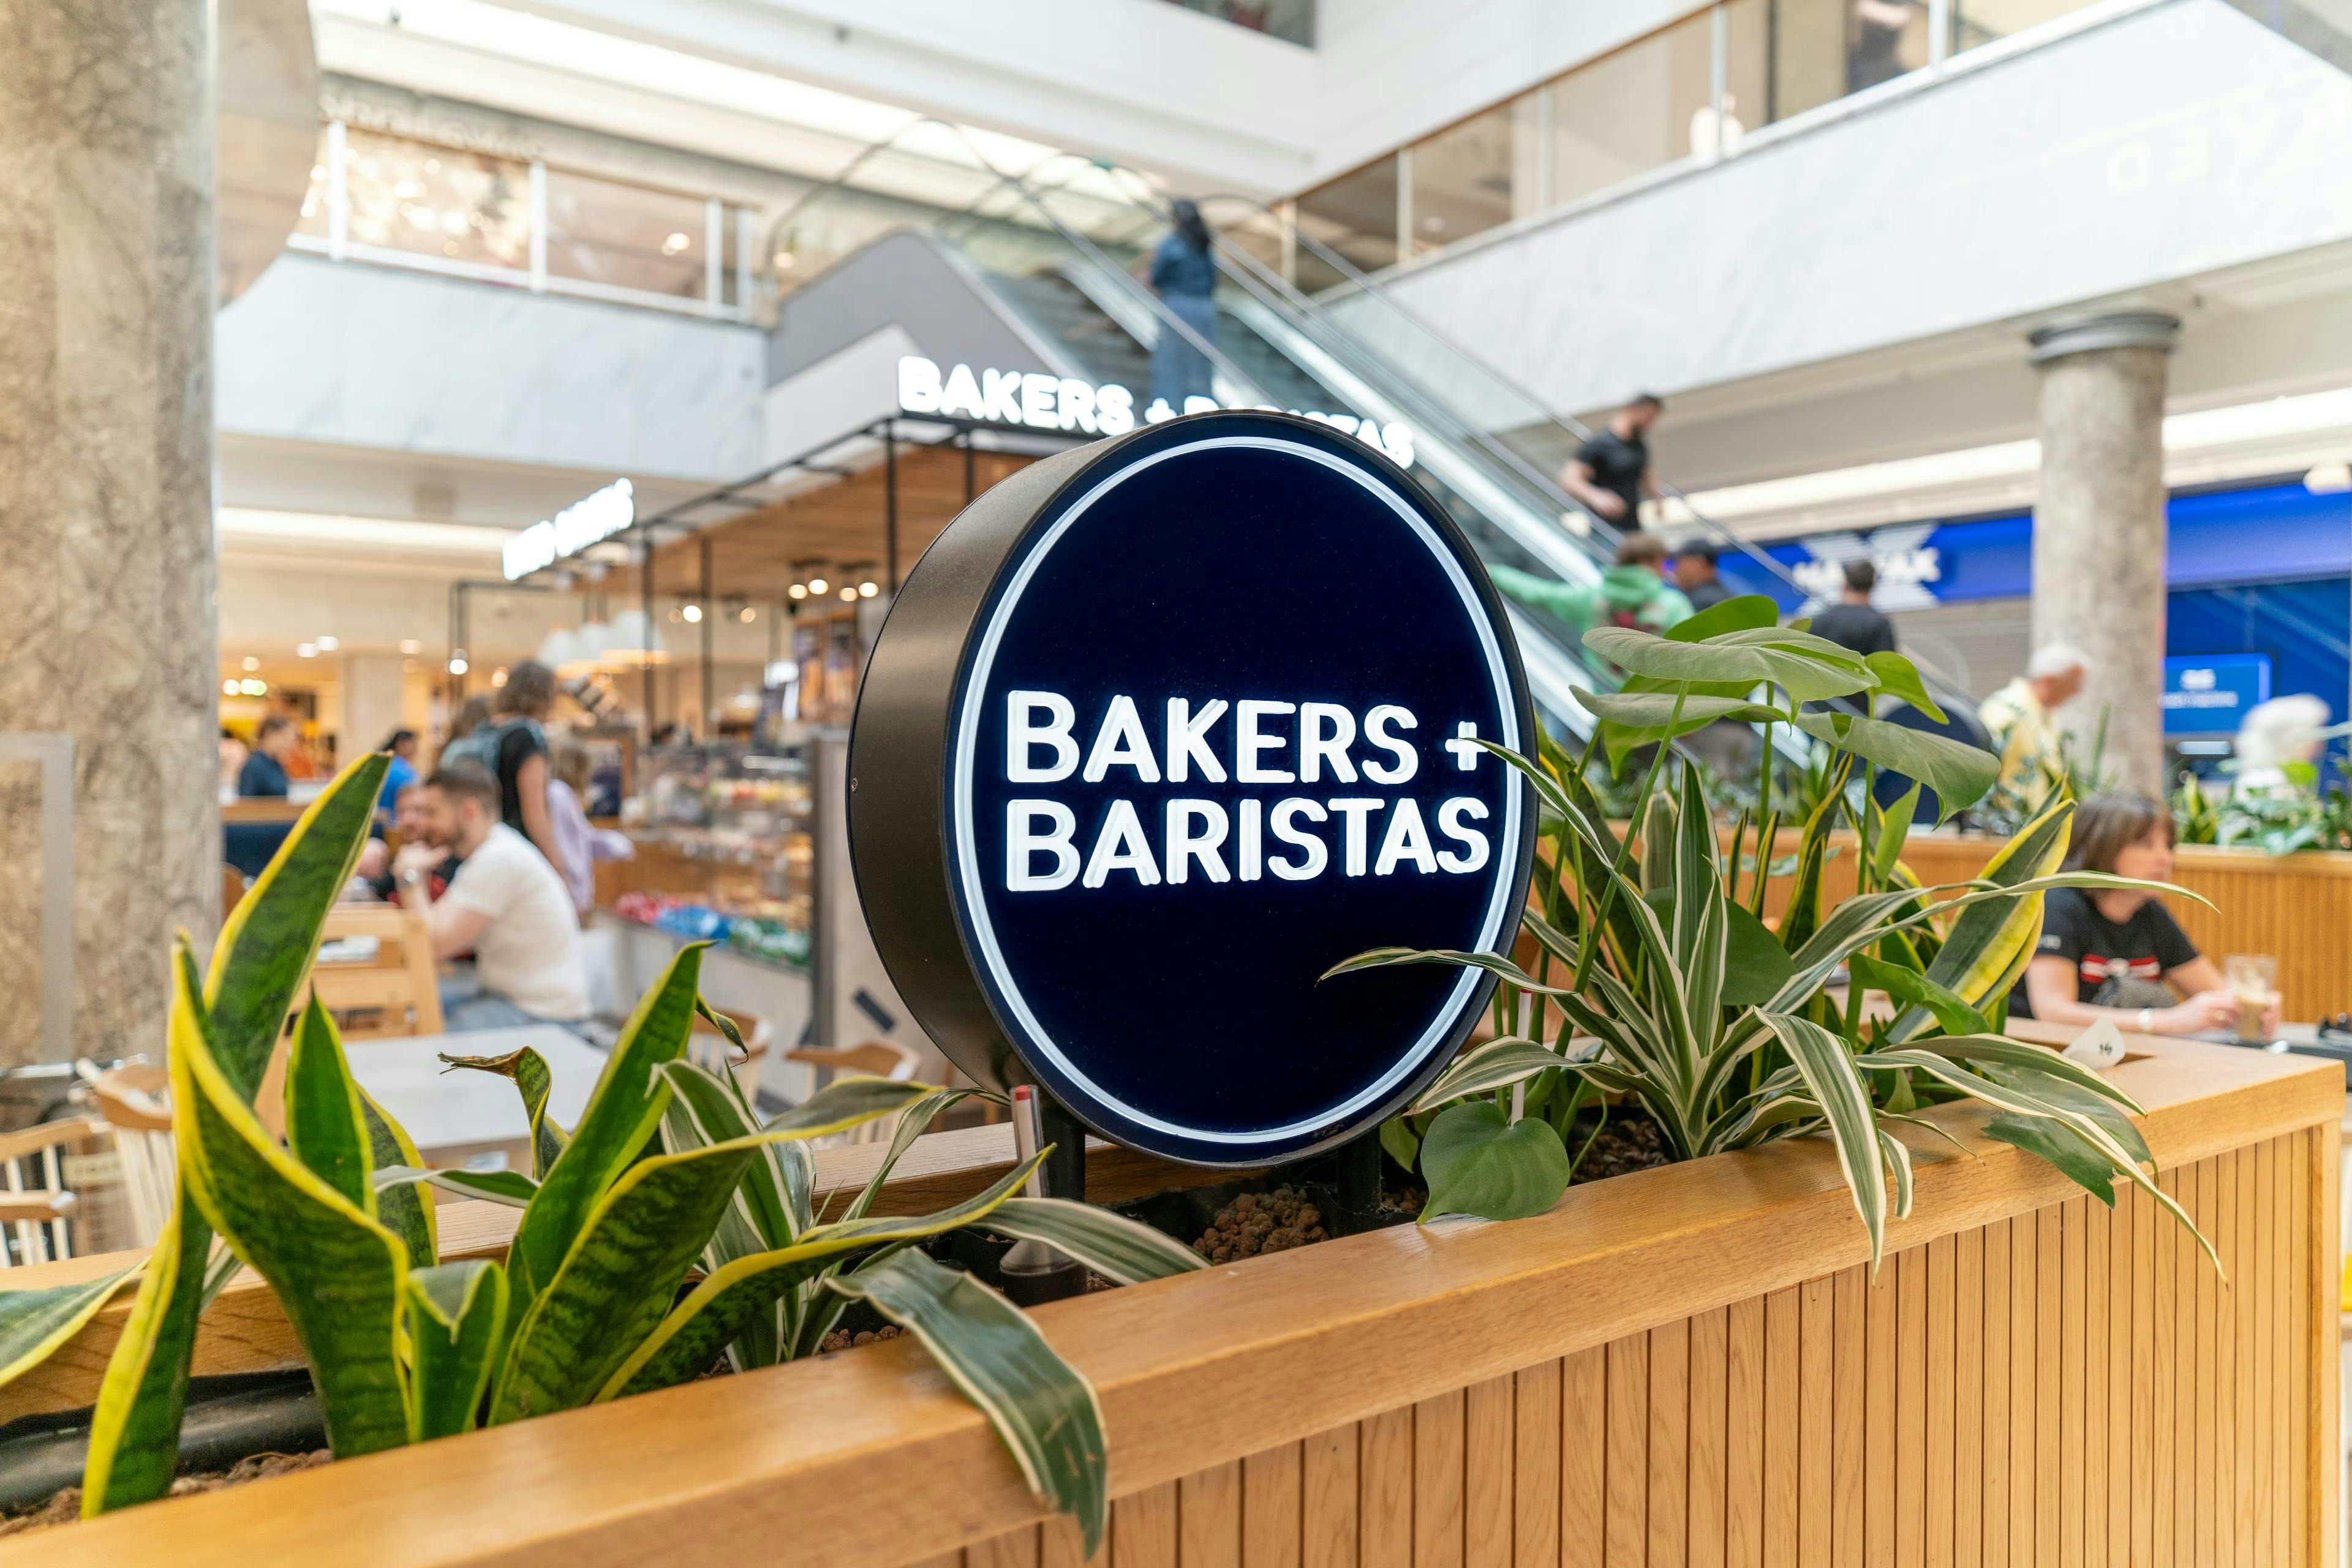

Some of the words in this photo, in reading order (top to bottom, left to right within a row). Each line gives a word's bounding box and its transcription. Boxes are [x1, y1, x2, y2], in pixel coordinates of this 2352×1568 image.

[897, 355, 1135, 436] BAKERS
[1007, 690, 1419, 785] BAKERS
[1445, 721, 1490, 771] +
[1006, 796, 1490, 892] BARISTAS
